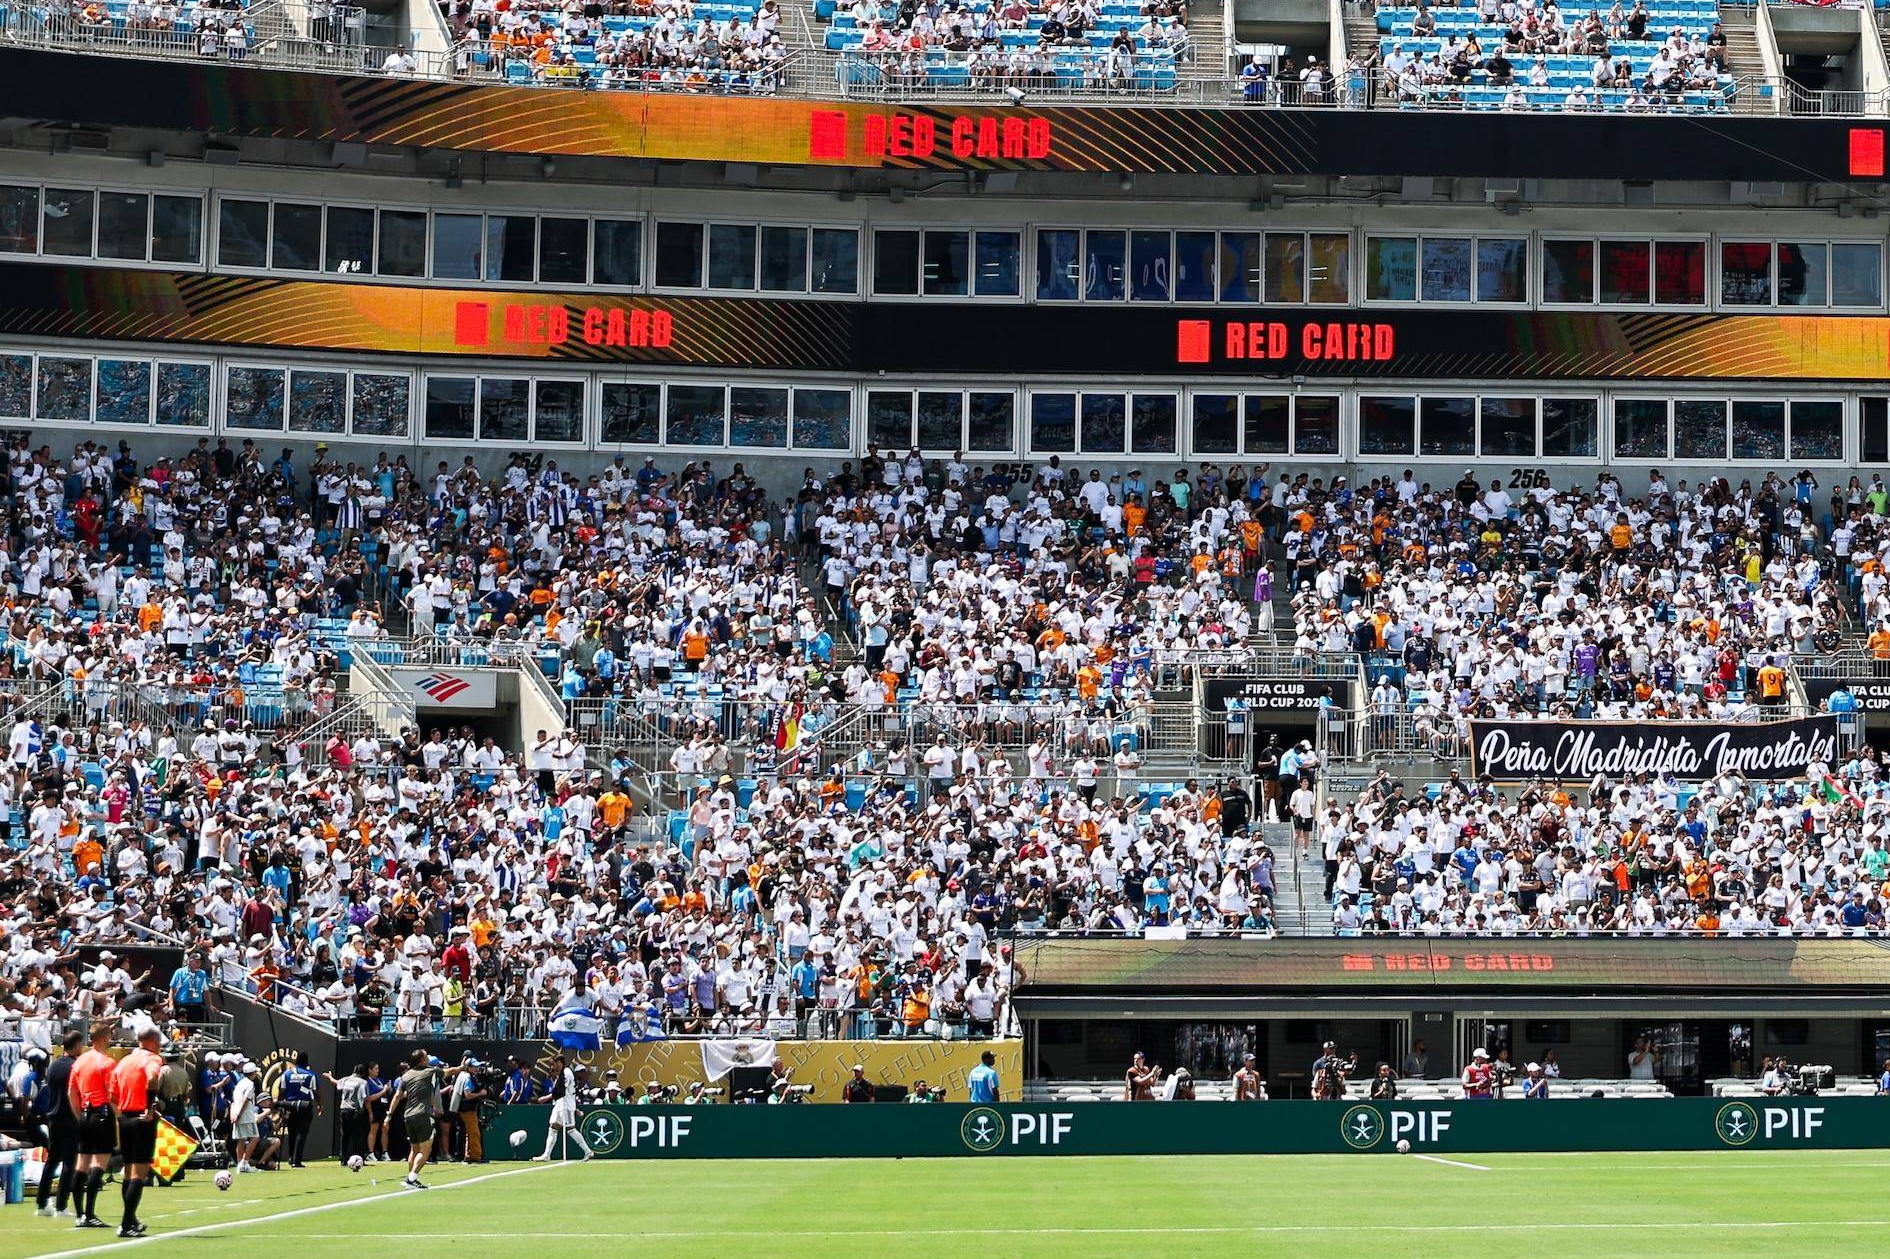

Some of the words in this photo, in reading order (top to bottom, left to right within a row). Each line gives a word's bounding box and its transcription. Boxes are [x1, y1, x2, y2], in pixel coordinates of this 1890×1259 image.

[864, 114, 935, 157] RED
[952, 116, 1050, 159] CARD
[504, 304, 568, 344] RED
[584, 307, 673, 347] CARD
[1227, 323, 1287, 359] RED
[1303, 324, 1394, 360] CARD
[1005, 463, 1034, 484] 55
[1509, 468, 1547, 489] 256
[1245, 684, 1273, 695] FIFA
[1273, 684, 1305, 695] CLUB
[1270, 697, 1293, 708] CUP
[1866, 698, 1890, 709] CUP
[1480, 729, 1553, 777] Peña
[1554, 724, 1702, 778] Madridista
[1704, 728, 1835, 776] Inmortales
[261, 1047, 298, 1068] WORLD
[630, 1115, 692, 1148] PIF
[1011, 1113, 1074, 1145] PIF
[1390, 1109, 1452, 1143] PIF
[1764, 1107, 1825, 1139] PIF
